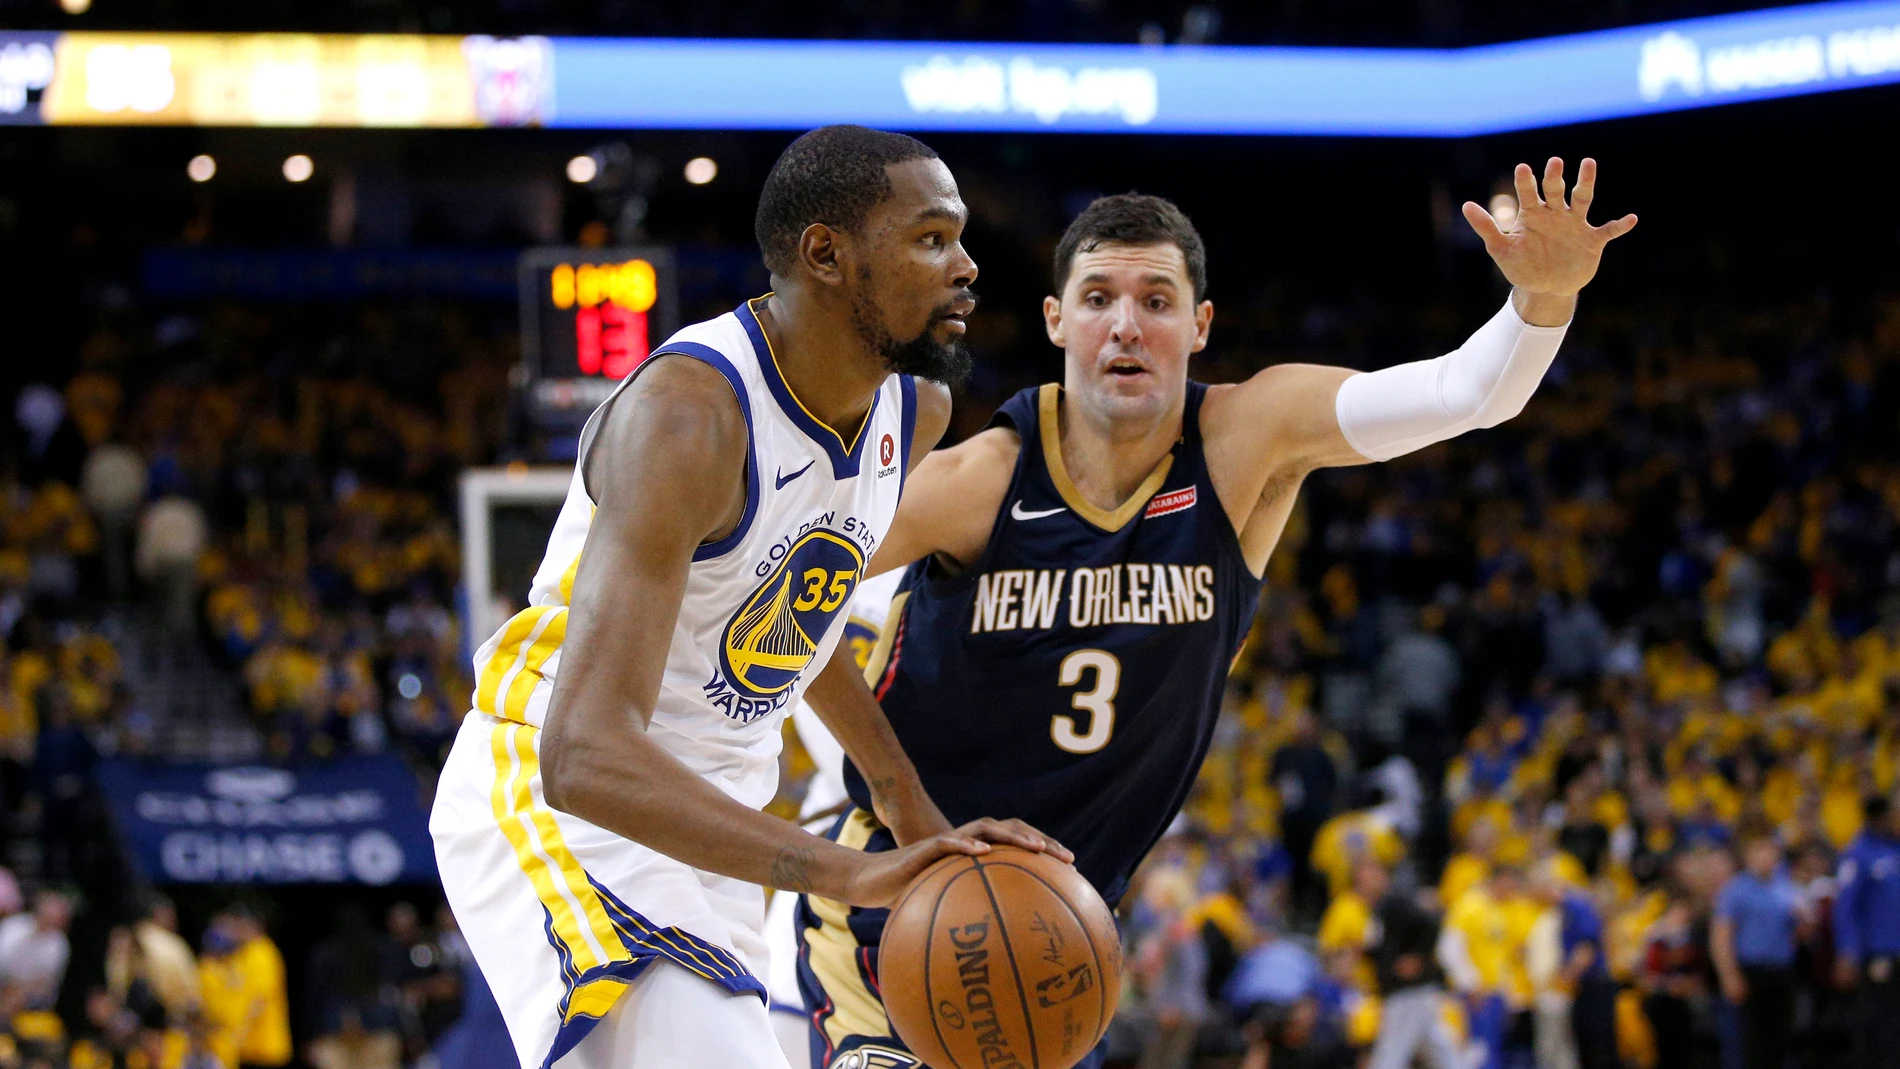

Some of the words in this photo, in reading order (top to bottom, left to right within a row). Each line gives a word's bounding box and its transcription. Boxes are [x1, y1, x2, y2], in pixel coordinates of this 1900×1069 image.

[792, 567, 857, 613] 35
[970, 569, 1067, 634] NEW
[1069, 563, 1215, 628] ORLEANS
[1050, 648, 1122, 755] 3
